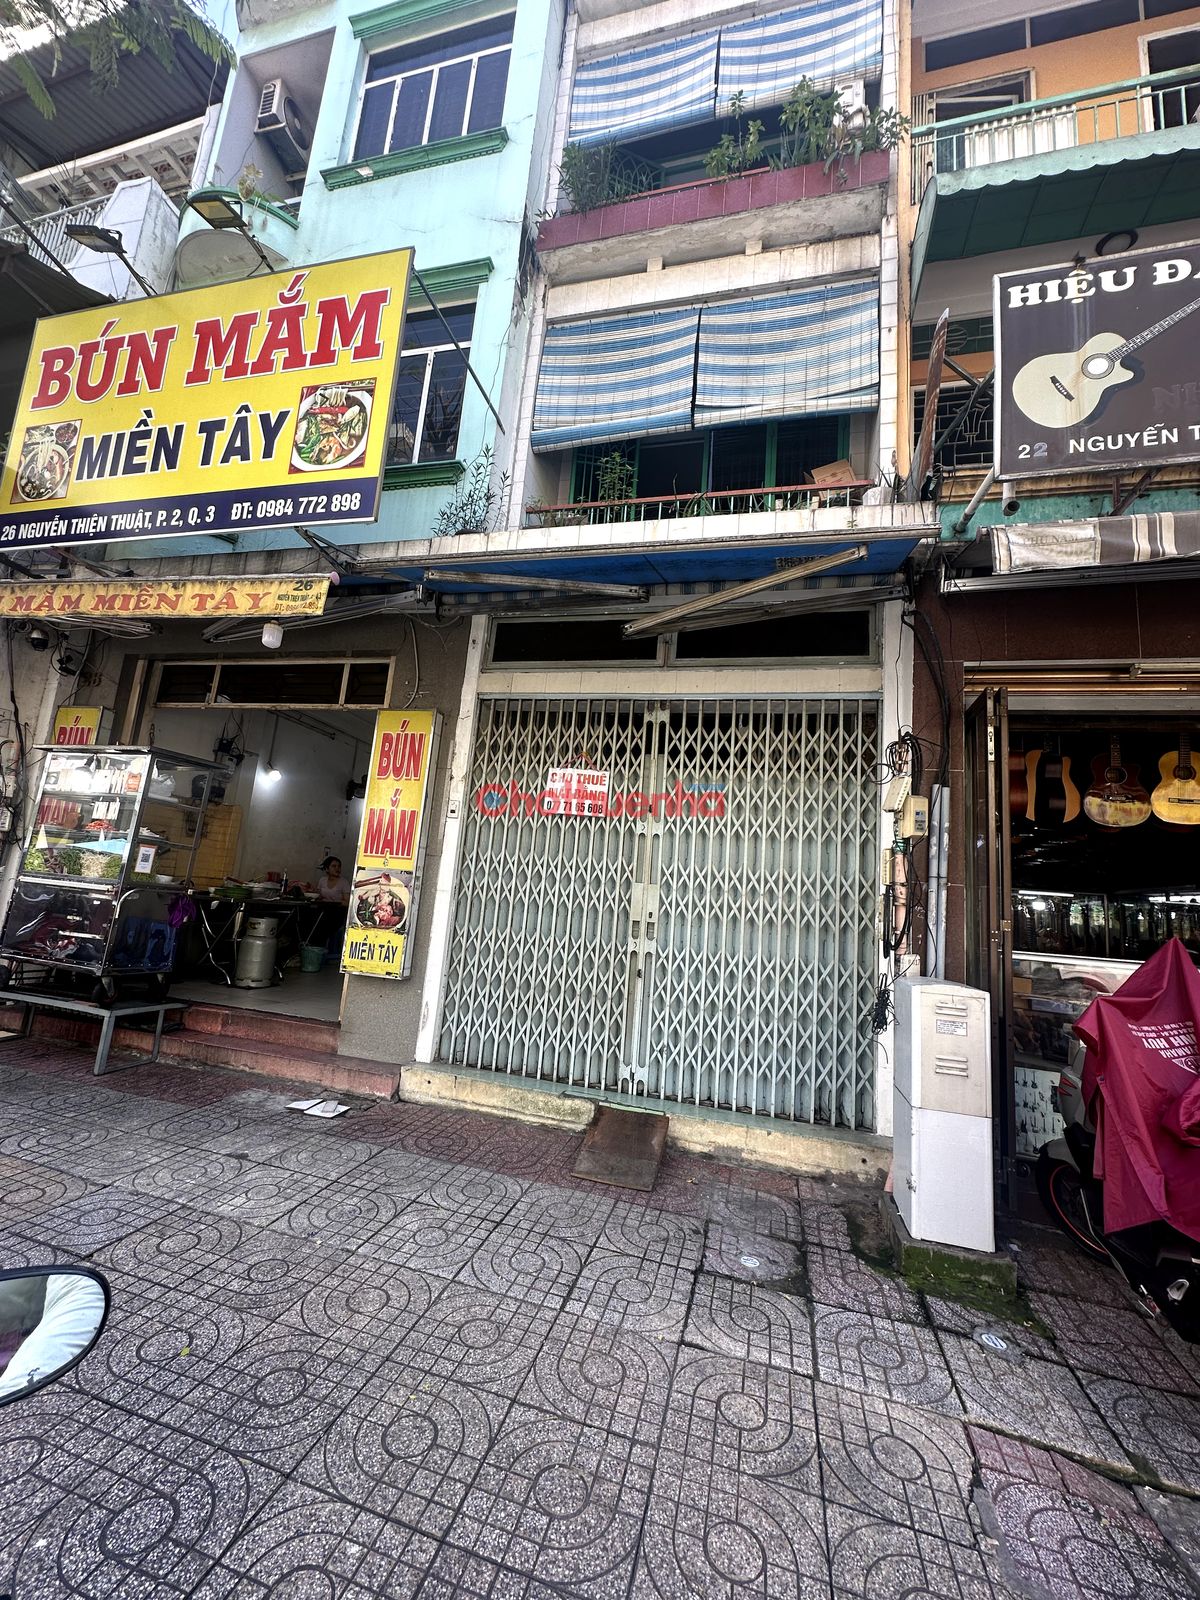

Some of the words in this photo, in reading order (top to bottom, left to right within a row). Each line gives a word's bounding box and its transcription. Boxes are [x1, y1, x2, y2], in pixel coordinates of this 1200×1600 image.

[1008, 270, 1137, 308] HIỆU
[1152, 259, 1200, 286] Đ
[30, 318, 179, 411] BÚN
[184, 271, 391, 387] MẮM
[75, 409, 185, 482] MIỀN
[197, 403, 292, 468] TÂY
[1018, 442, 1048, 459] 22
[1069, 423, 1179, 454] NGUYỄN
[1, 525, 16, 541] 26
[18, 515, 66, 539] NGUYỄN
[70, 513, 108, 536] THIỆN
[111, 509, 153, 532] THUẬT,
[156, 510, 167, 527] P.
[171, 508, 183, 526] 2,
[187, 507, 201, 526] Q.
[205, 505, 216, 522] 3
[230, 502, 253, 521] ĐT:
[256, 498, 294, 518] 0984
[298, 495, 327, 514] 772
[330, 492, 362, 512] 898
[90, 584, 183, 611] MIỀN
[191, 586, 272, 611] TÂY
[292, 580, 313, 591] 26
[376, 720, 425, 780] BÚN
[577, 773, 607, 786] THUÊ
[363, 788, 418, 859] MẮM
[563, 801, 572, 811] 71
[587, 803, 603, 814] 608
[348, 935, 376, 962] MIỀN
[378, 939, 399, 964] TÂY
[1141, 1037, 1170, 1048] HUY
